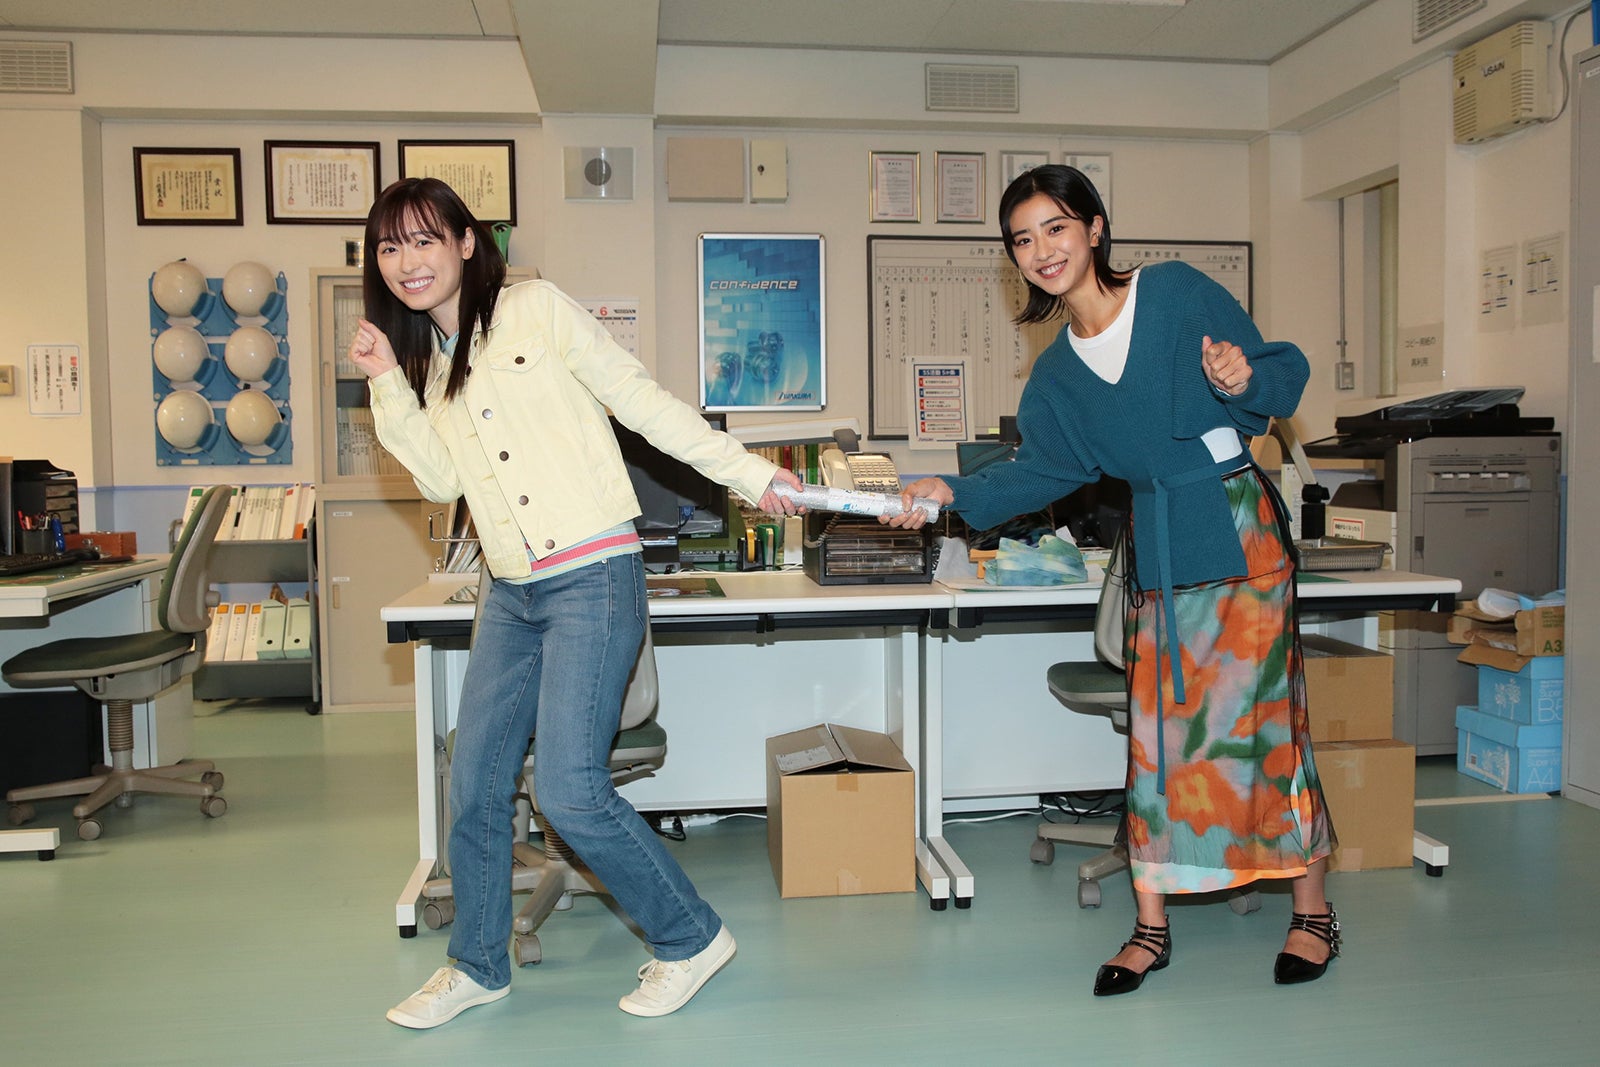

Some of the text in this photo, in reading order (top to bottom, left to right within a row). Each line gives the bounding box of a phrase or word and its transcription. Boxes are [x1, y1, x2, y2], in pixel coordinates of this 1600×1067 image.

[710, 281, 798, 290] confidence
[600, 307, 607, 316] 6
[1543, 640, 1562, 653] A3
[1526, 767, 1555, 790] A4
